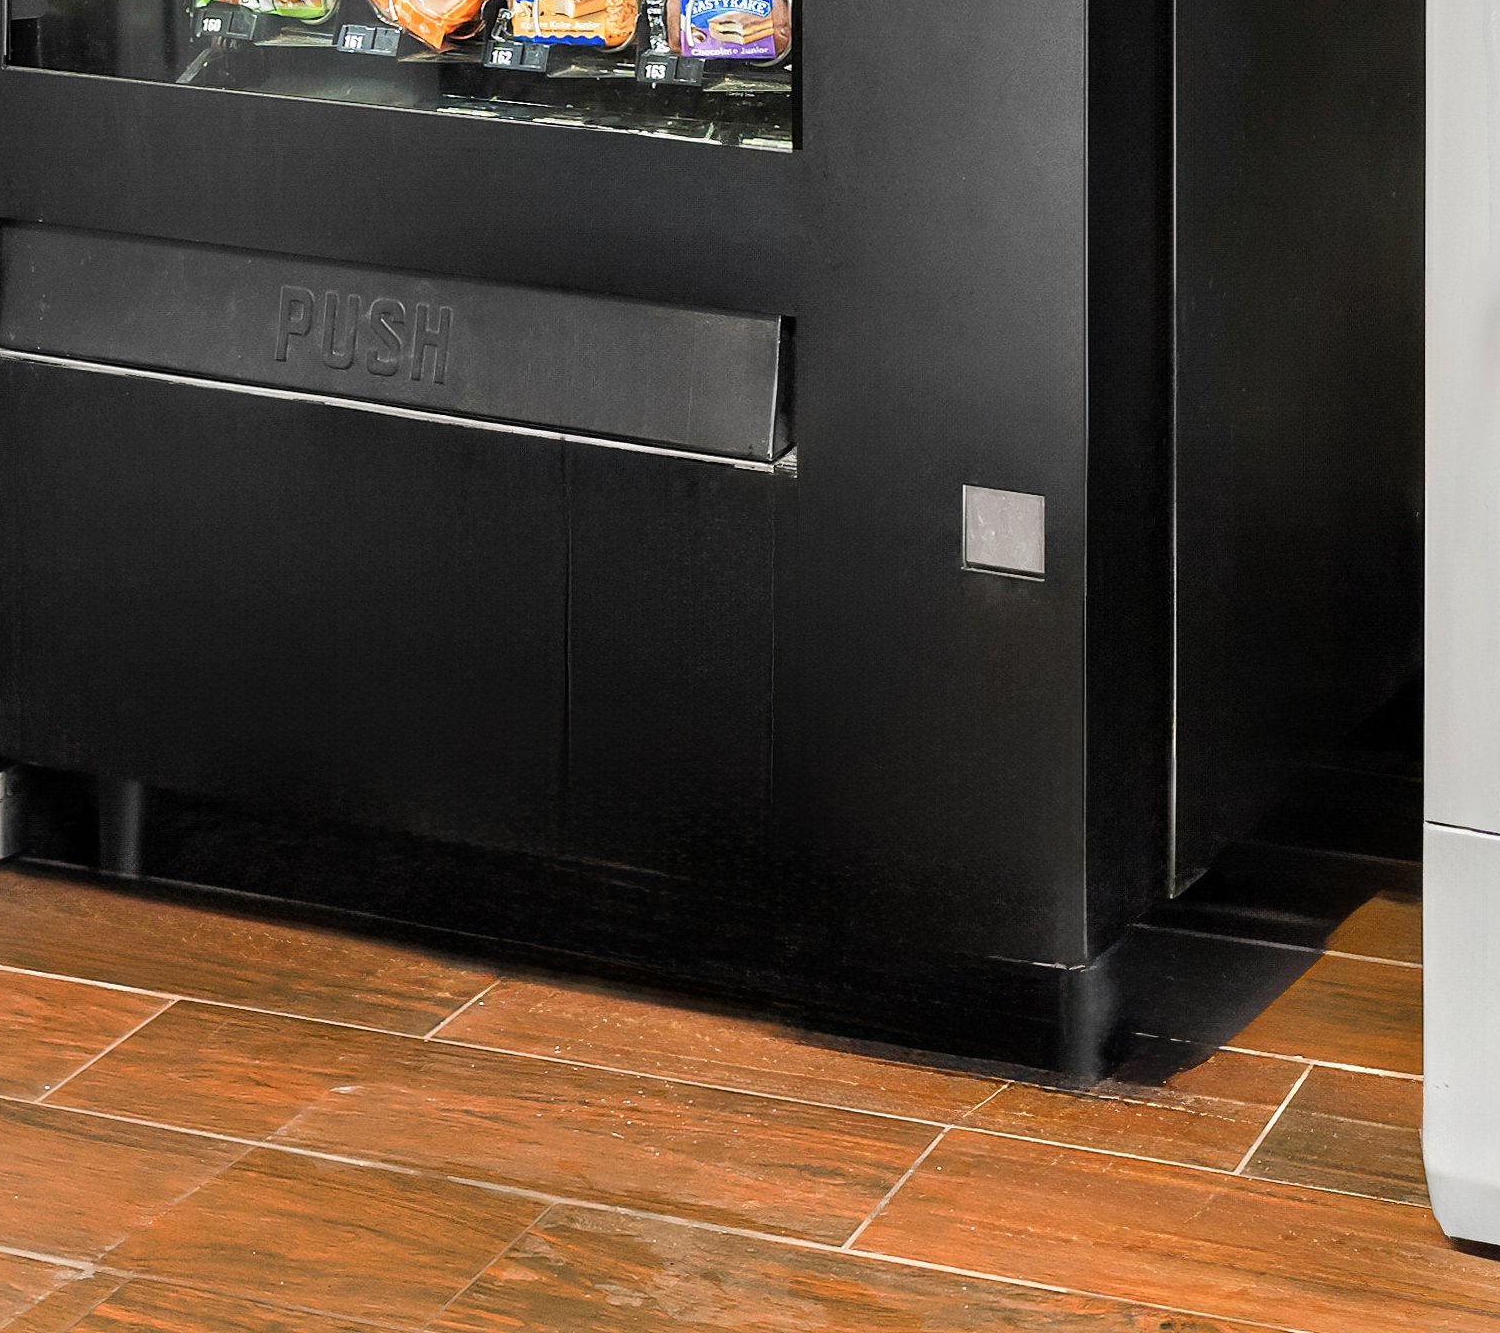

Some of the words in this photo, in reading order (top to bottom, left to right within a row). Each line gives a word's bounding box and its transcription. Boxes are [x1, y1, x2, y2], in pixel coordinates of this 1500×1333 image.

[202, 18, 222, 31] 160
[344, 35, 363, 49] 161
[492, 49, 512, 64] 162
[691, 45, 739, 56] Chocolate
[274, 284, 456, 386] PUSH
